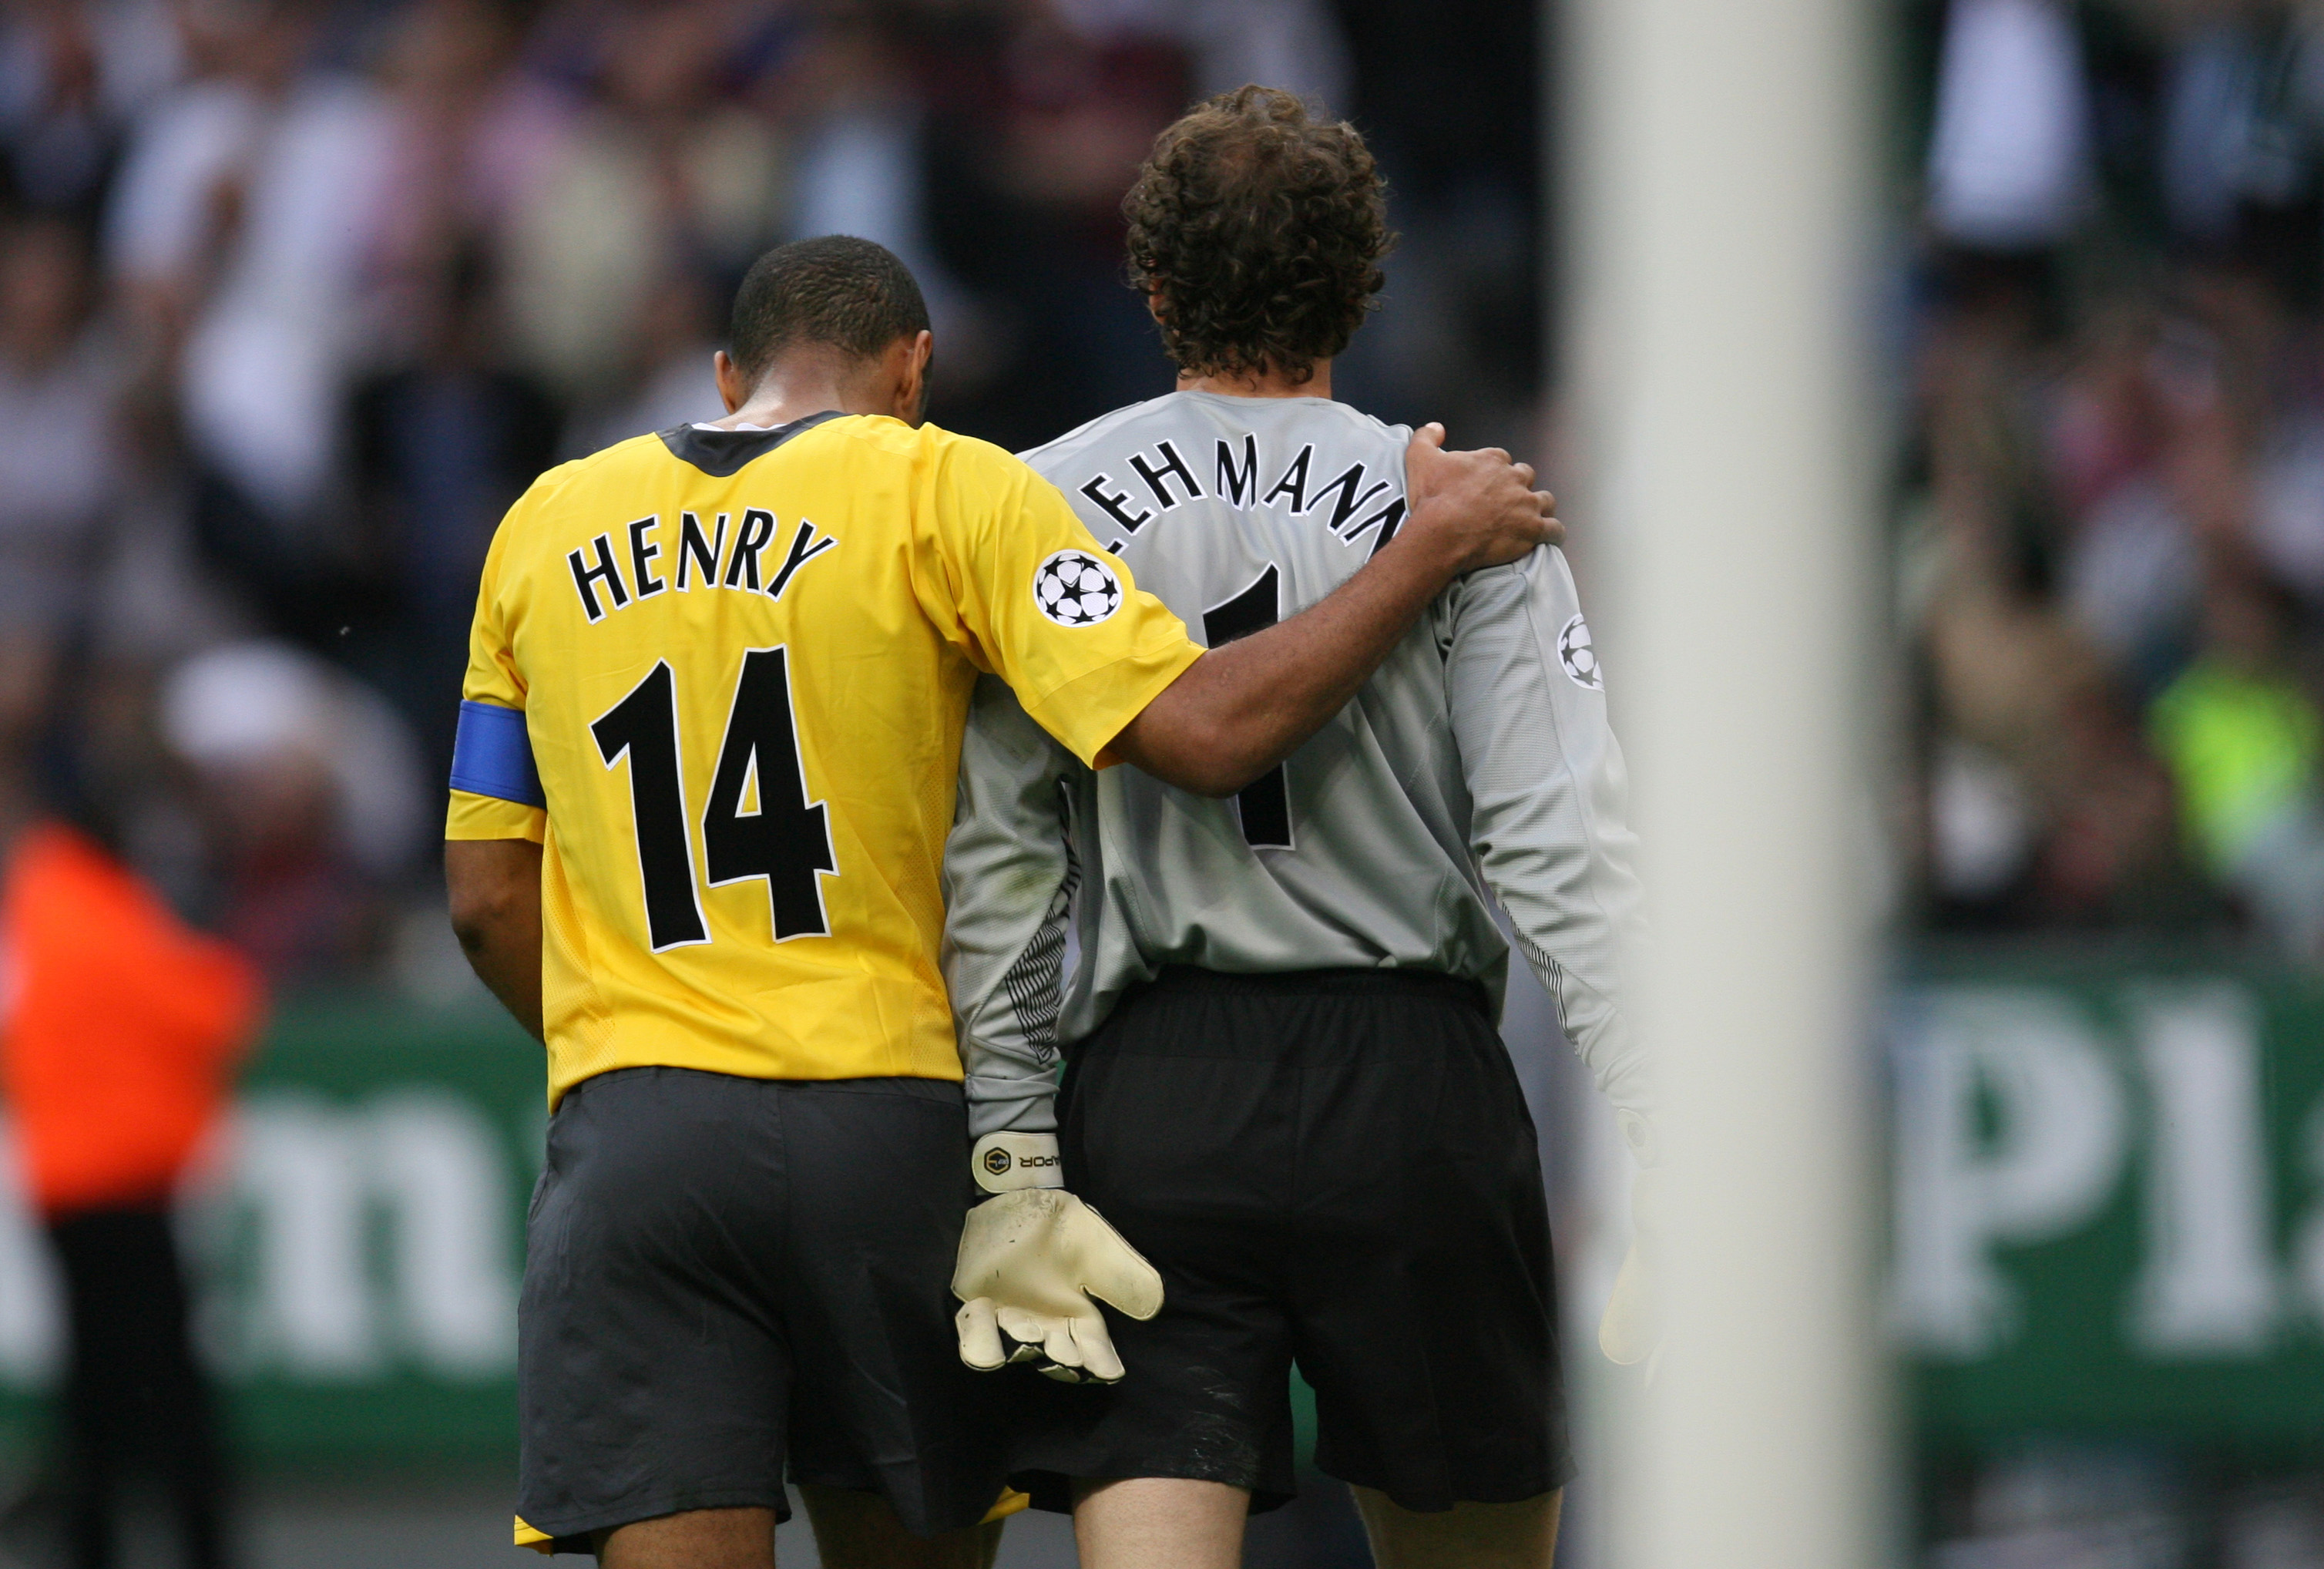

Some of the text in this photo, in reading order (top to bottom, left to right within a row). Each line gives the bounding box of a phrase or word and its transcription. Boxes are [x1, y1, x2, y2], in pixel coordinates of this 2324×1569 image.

[566, 506, 839, 625] HENRY
[1078, 432, 1407, 563] EHMANN
[587, 643, 841, 954] 14
[1884, 983, 2324, 1360] Pl
